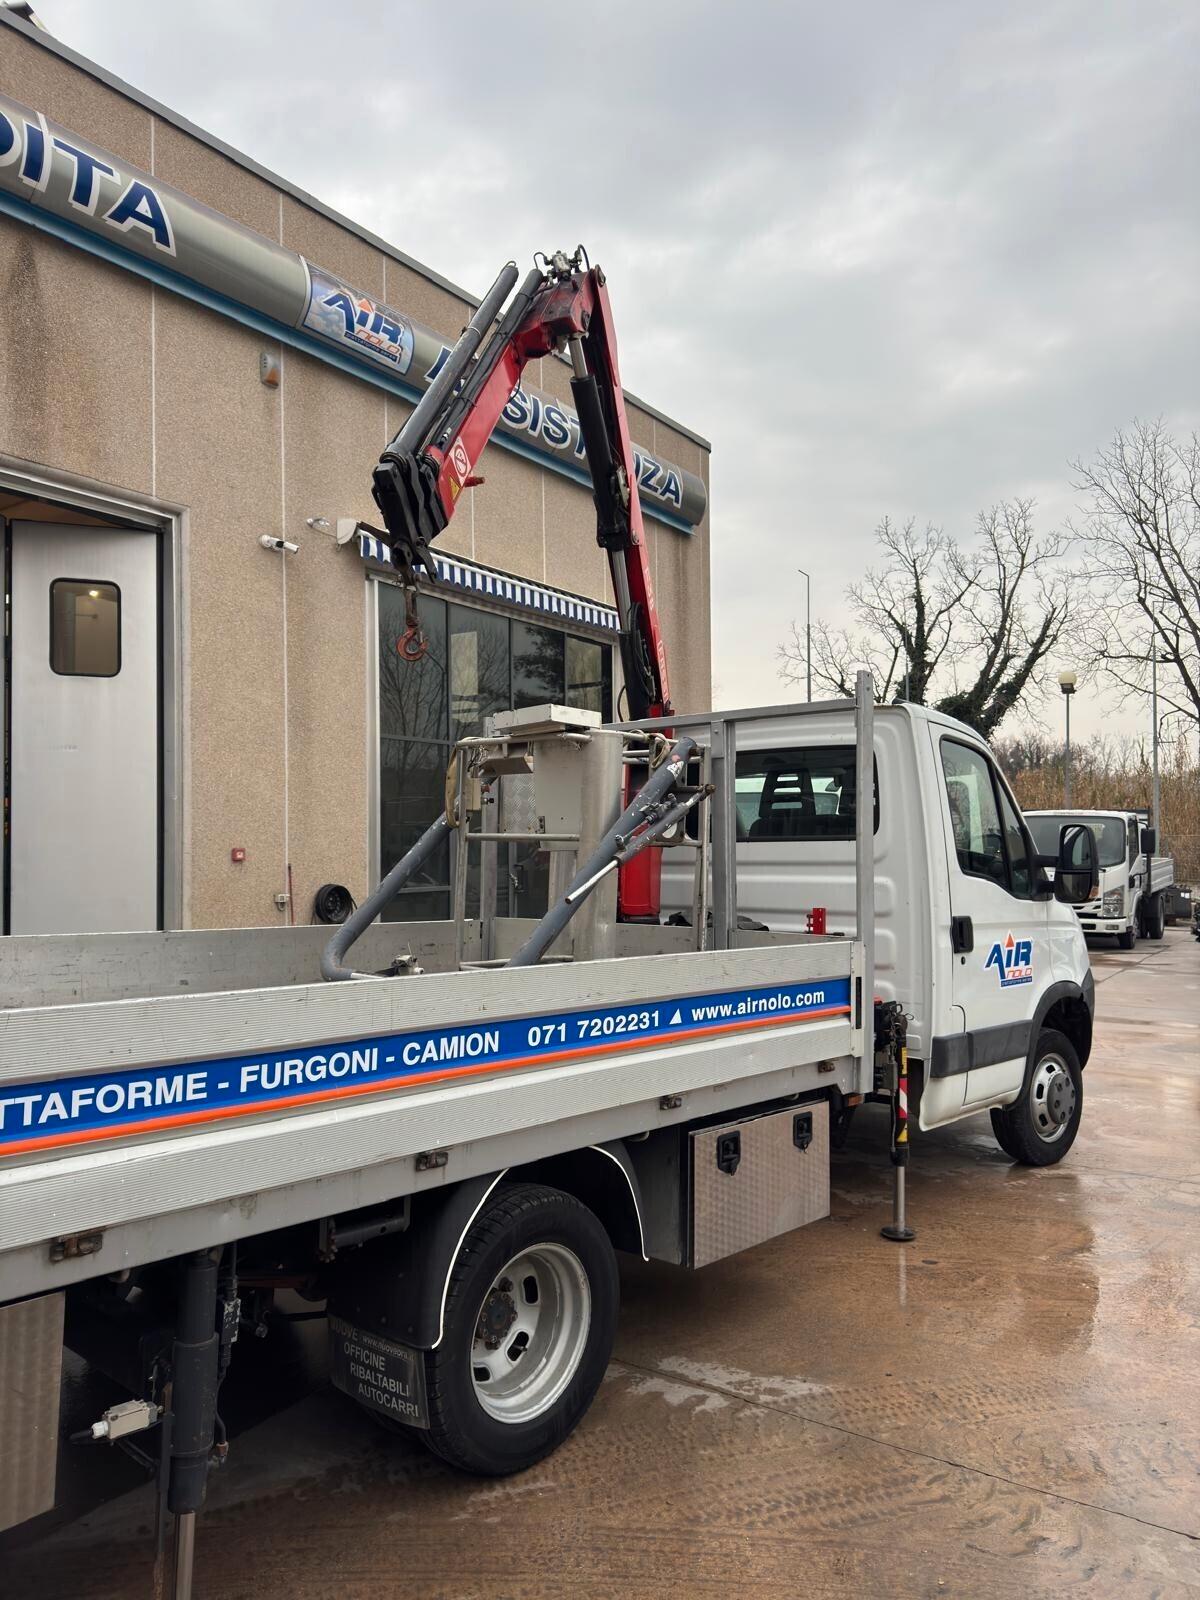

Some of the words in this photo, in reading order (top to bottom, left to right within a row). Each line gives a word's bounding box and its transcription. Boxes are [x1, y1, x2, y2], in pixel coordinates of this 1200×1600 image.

[527, 1022, 568, 1047] 071
[577, 1010, 660, 1039] 7202231
[691, 990, 825, 1022] www.airnolo.com
[239, 1047, 379, 1093] FURGONI
[402, 1030, 500, 1067] CAMION
[344, 1342, 385, 1371] OFFICINE
[351, 1362, 409, 1397] RIBALTABILI
[358, 1383, 418, 1417] AUTOCARRI
